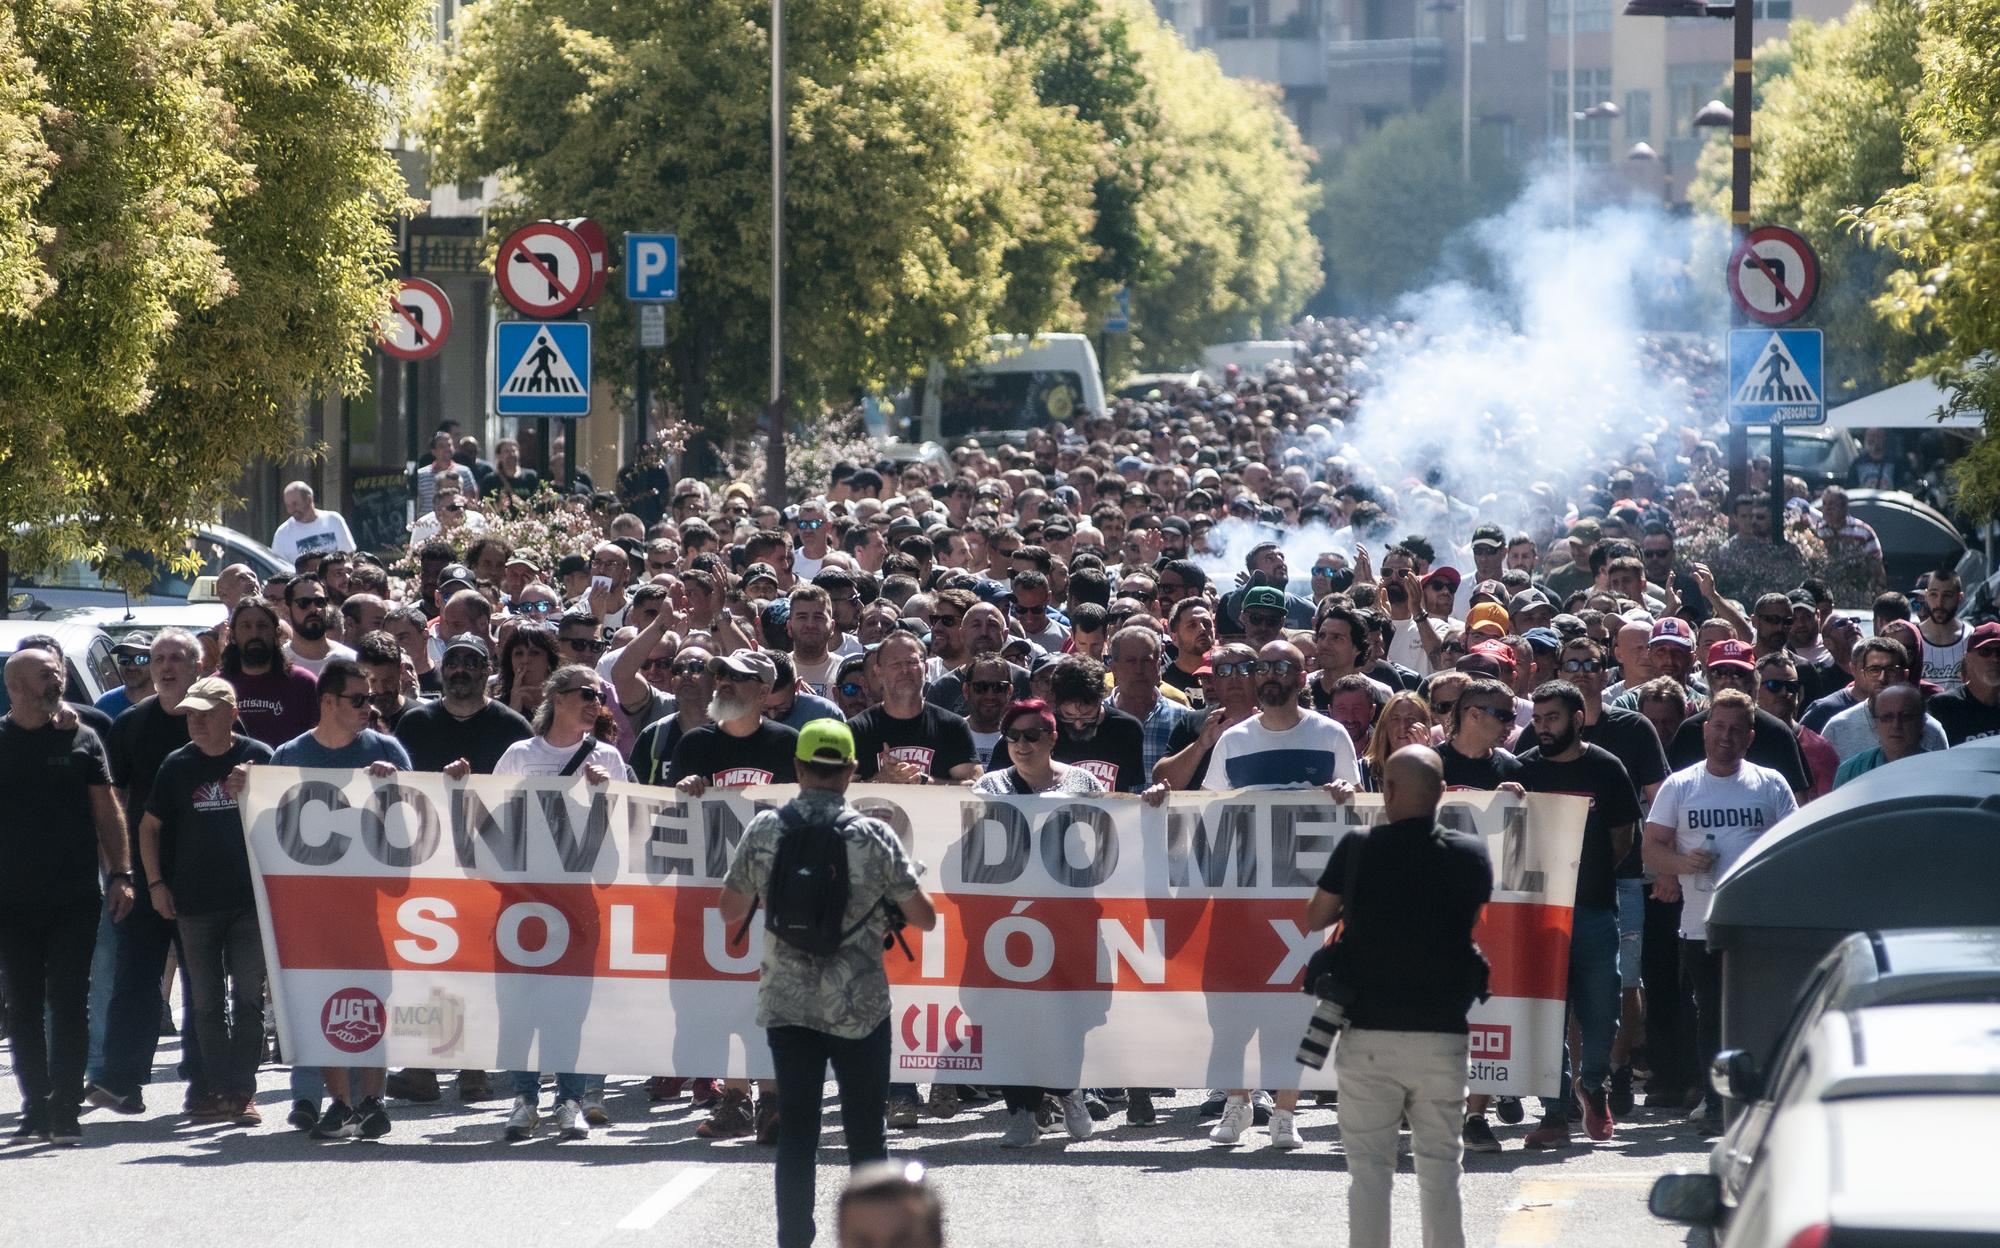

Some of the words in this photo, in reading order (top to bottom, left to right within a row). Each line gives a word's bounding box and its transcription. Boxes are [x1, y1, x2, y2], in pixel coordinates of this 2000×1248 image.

[636, 242, 667, 292] P
[724, 770, 770, 786] METAL
[1688, 808, 1765, 829] BUDDHA
[960, 800, 1120, 889] DO
[393, 896, 1166, 984] SOLUIÓN
[328, 998, 379, 1025] UGT
[395, 1006, 443, 1025] MCA
[901, 1003, 983, 1054] CIG
[901, 1056, 981, 1069] INDUSTRIA
